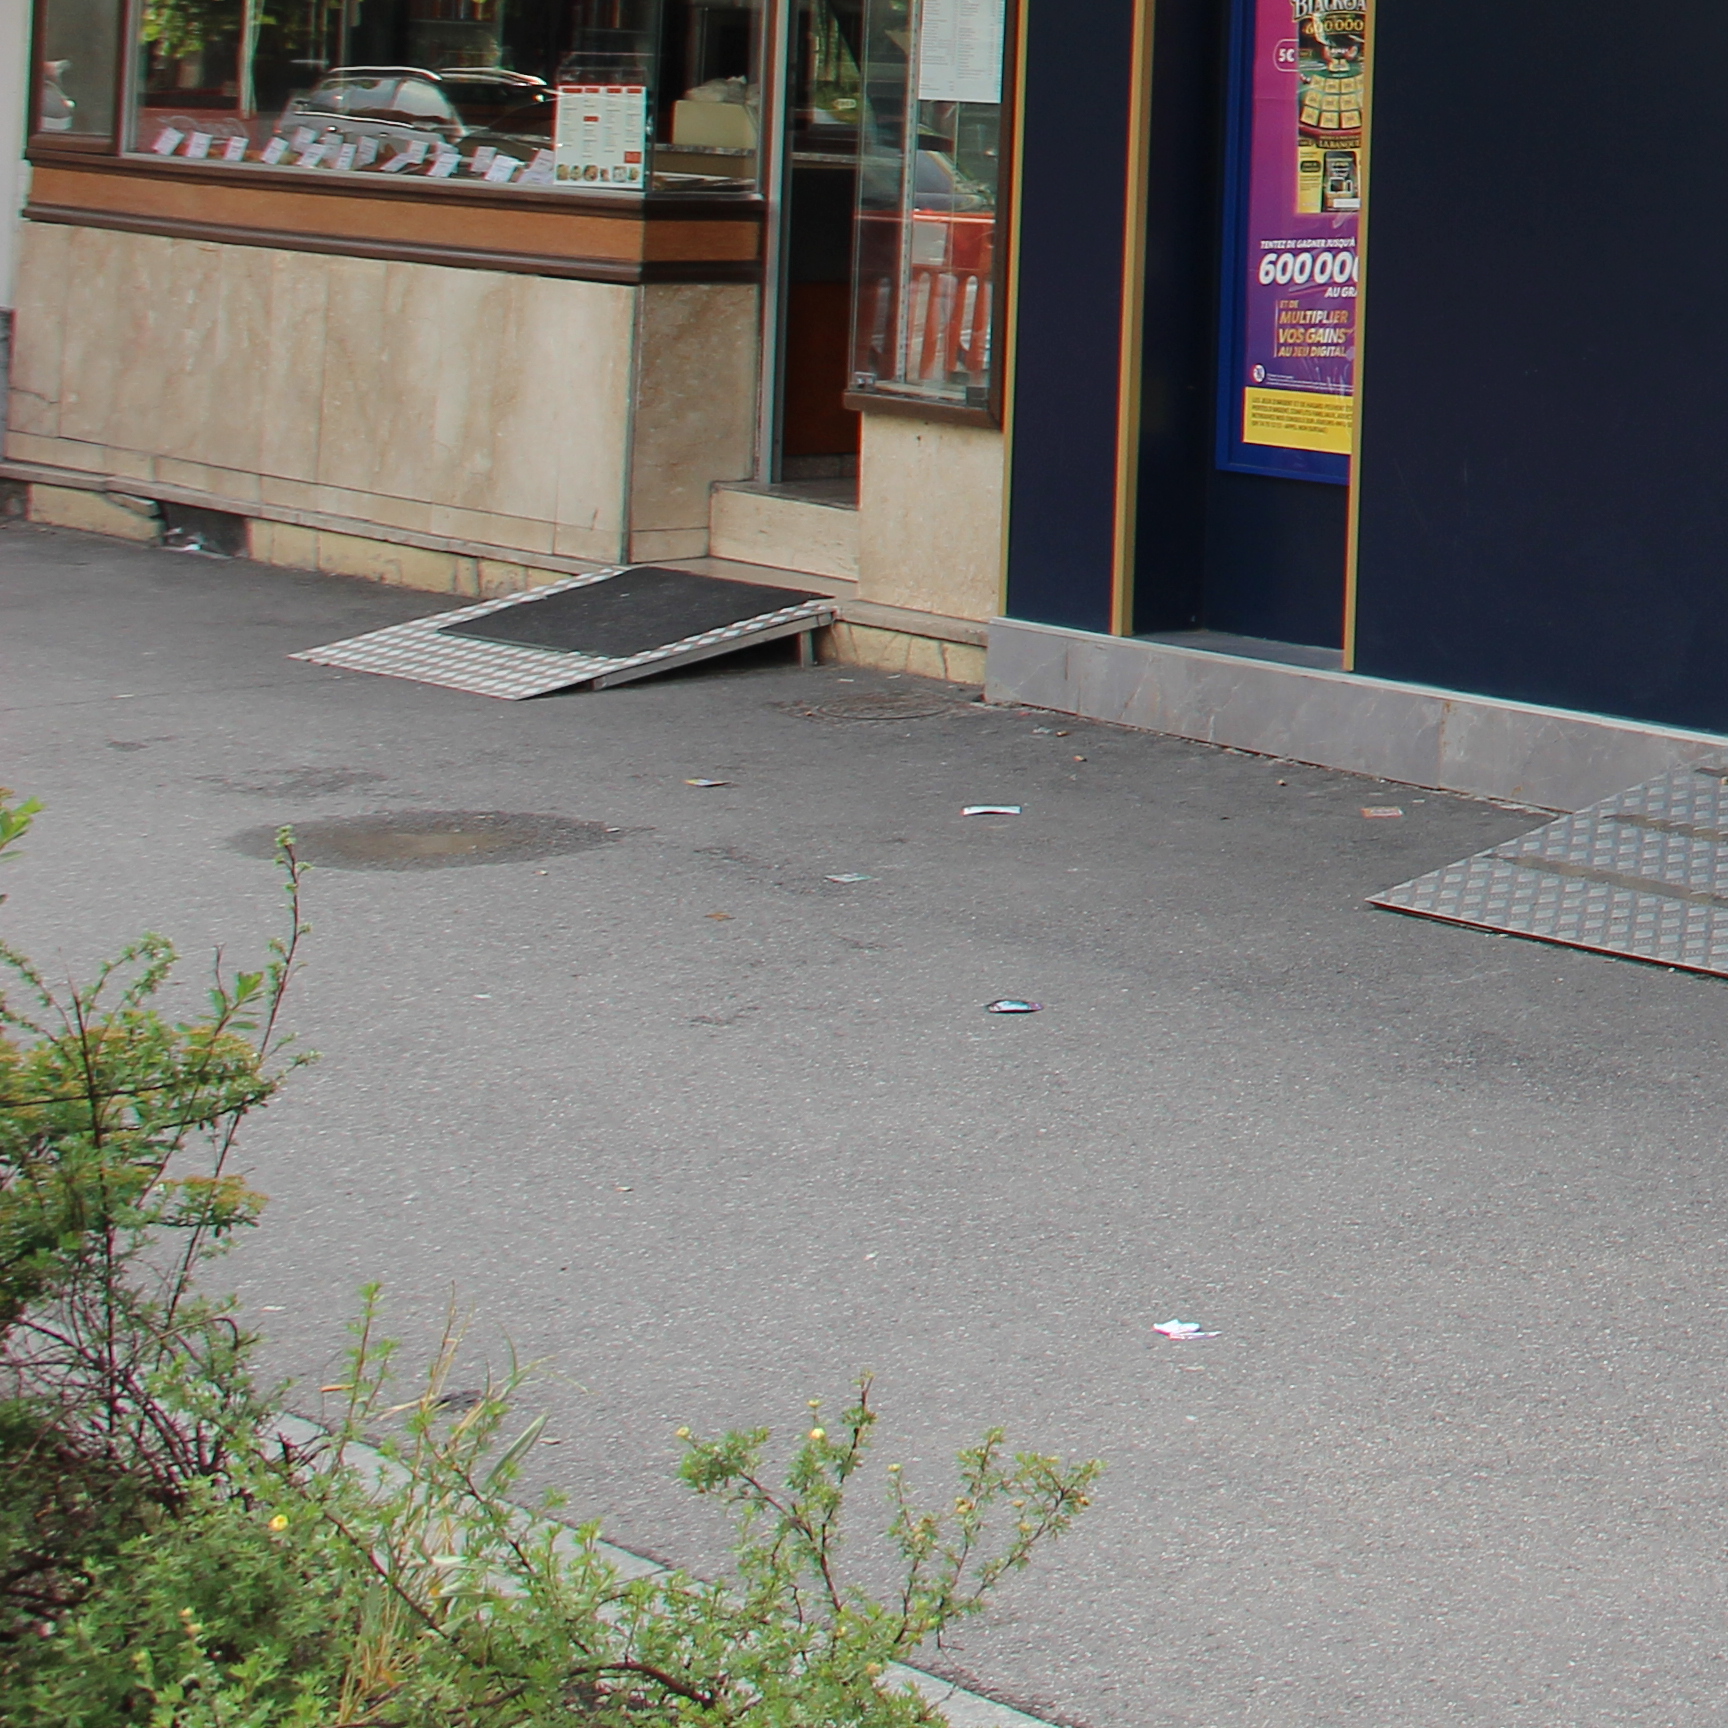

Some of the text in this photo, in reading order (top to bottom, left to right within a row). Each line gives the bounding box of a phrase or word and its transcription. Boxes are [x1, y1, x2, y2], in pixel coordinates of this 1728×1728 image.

[1258, 250, 1359, 286] 600 00
[1325, 288, 1340, 298] AU
[1279, 309, 1349, 325] MULTIPLIER
[1278, 328, 1304, 344] VOS
[1278, 346, 1347, 358] AU JEU DIGITAL
